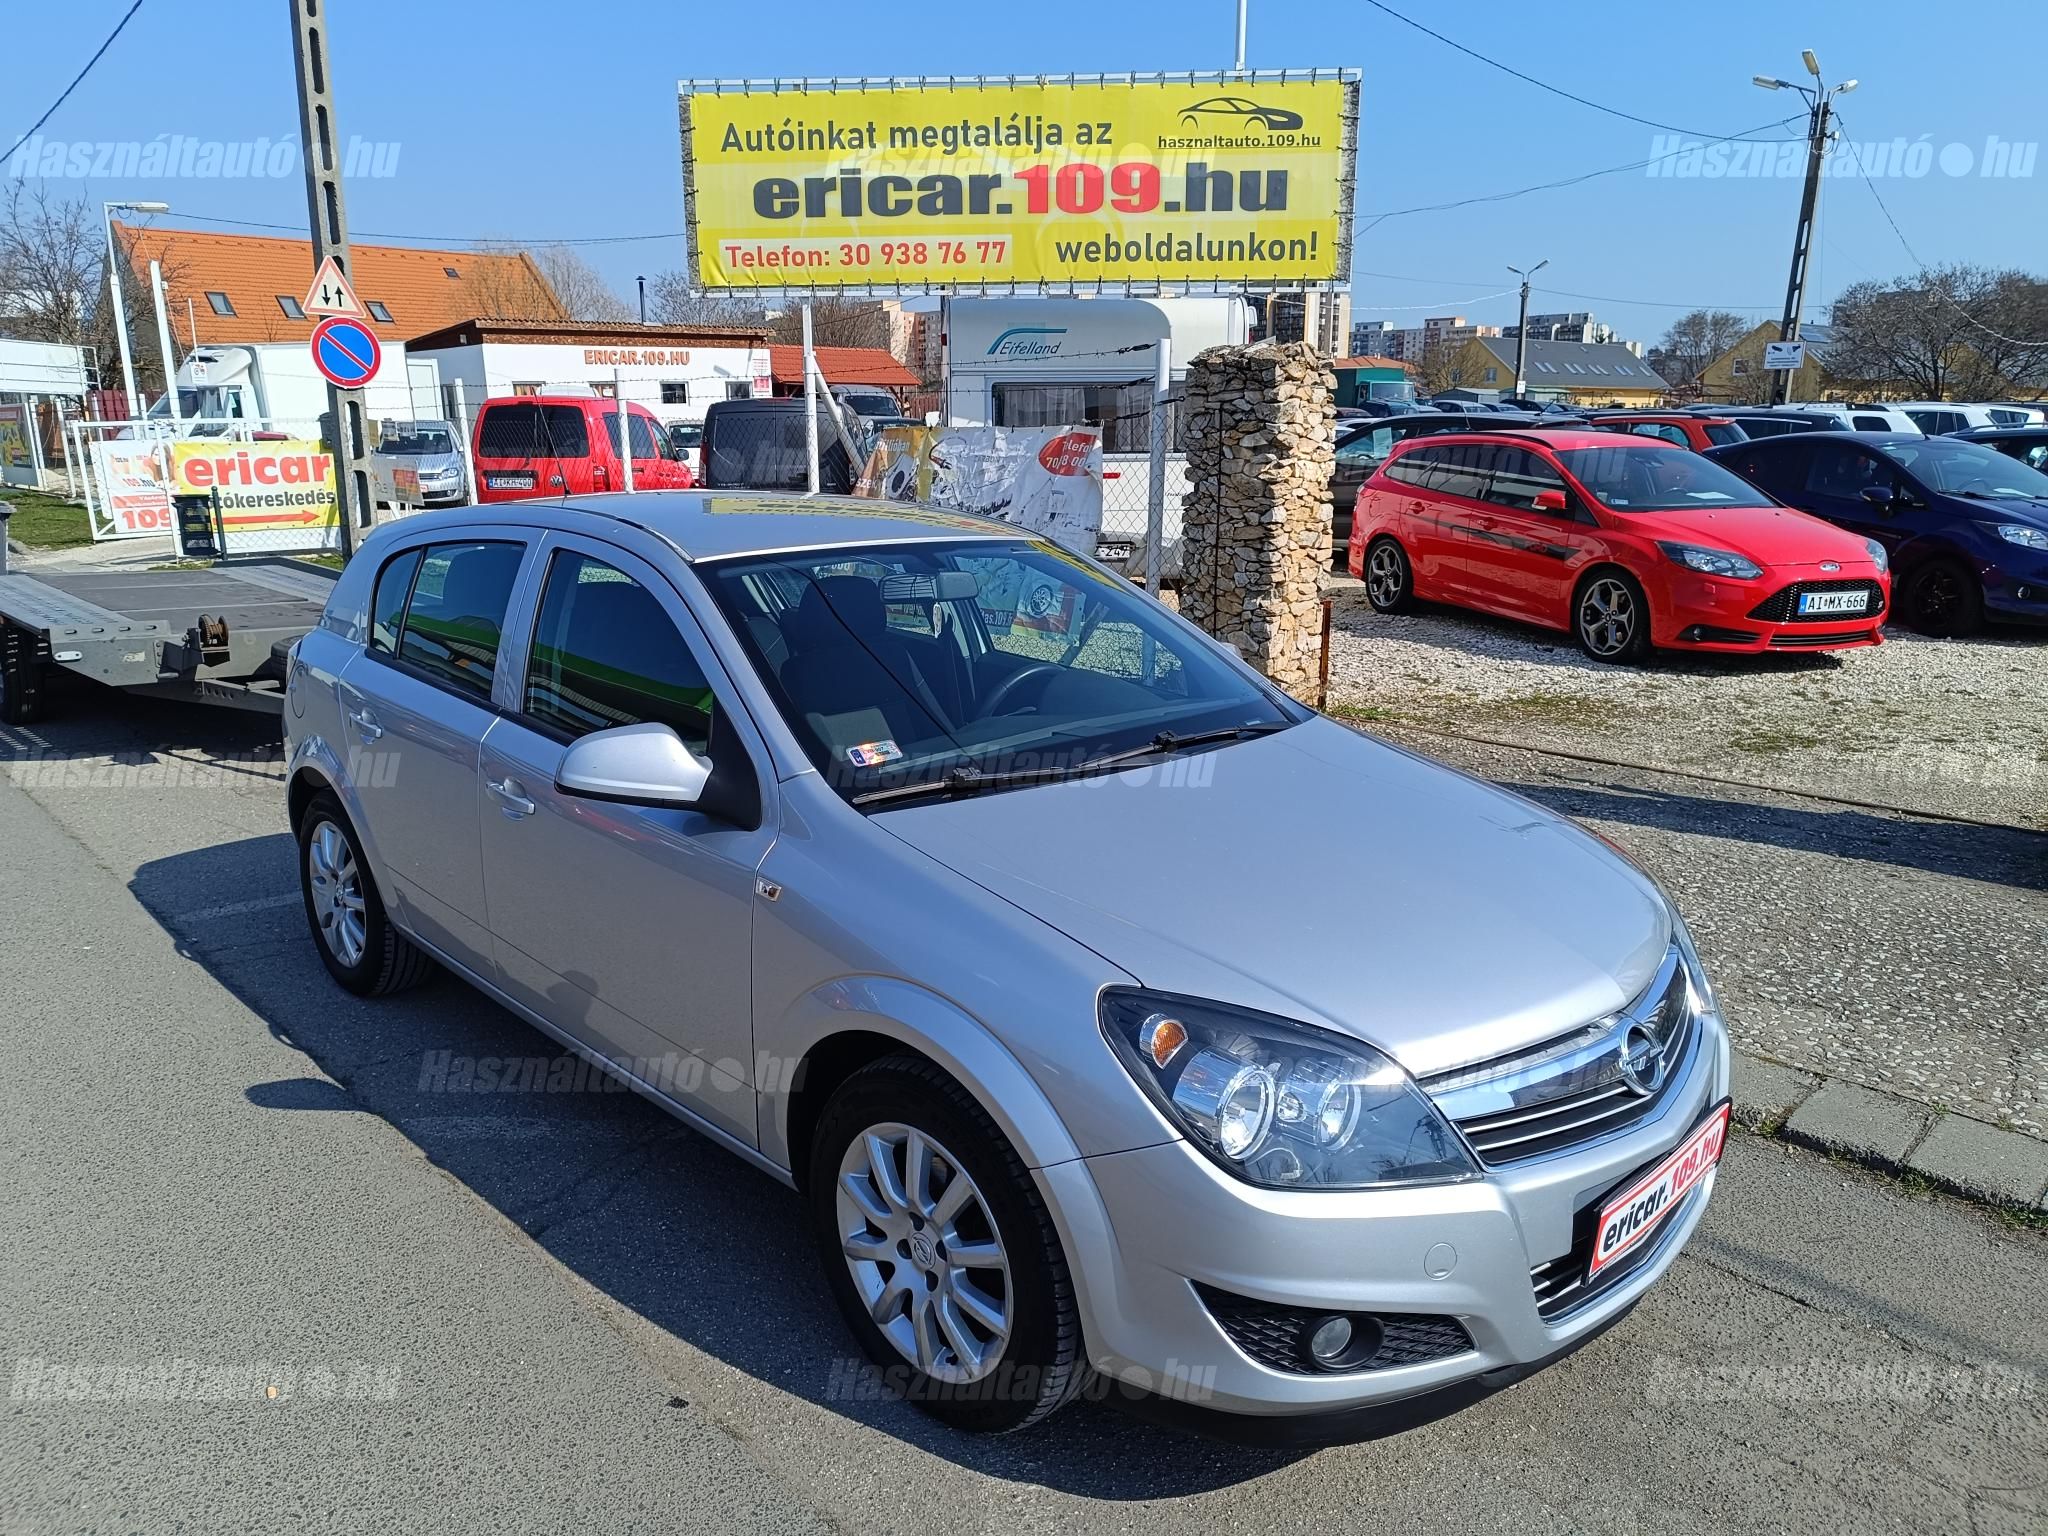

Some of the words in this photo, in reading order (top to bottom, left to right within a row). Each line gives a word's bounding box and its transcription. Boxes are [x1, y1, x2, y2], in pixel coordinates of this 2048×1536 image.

[721, 117, 877, 152] Autóinkat
[890, 112, 1062, 155] megtalálja
[1075, 122, 1112, 145] az
[1158, 134, 1321, 148] hasznaltauto.109.hu
[753, 162, 1288, 219] ericar.109.hu
[725, 245, 830, 268] Telefon:
[839, 243, 870, 266] 30
[880, 242, 928, 265] 938
[938, 241, 966, 264] 76
[976, 241, 1006, 263] 77
[1055, 231, 1318, 263] weboldalunkon!
[584, 350, 691, 366] ERICAR.109.HU
[1000, 341, 1062, 355] Eifelland
[184, 451, 331, 487] ericar
